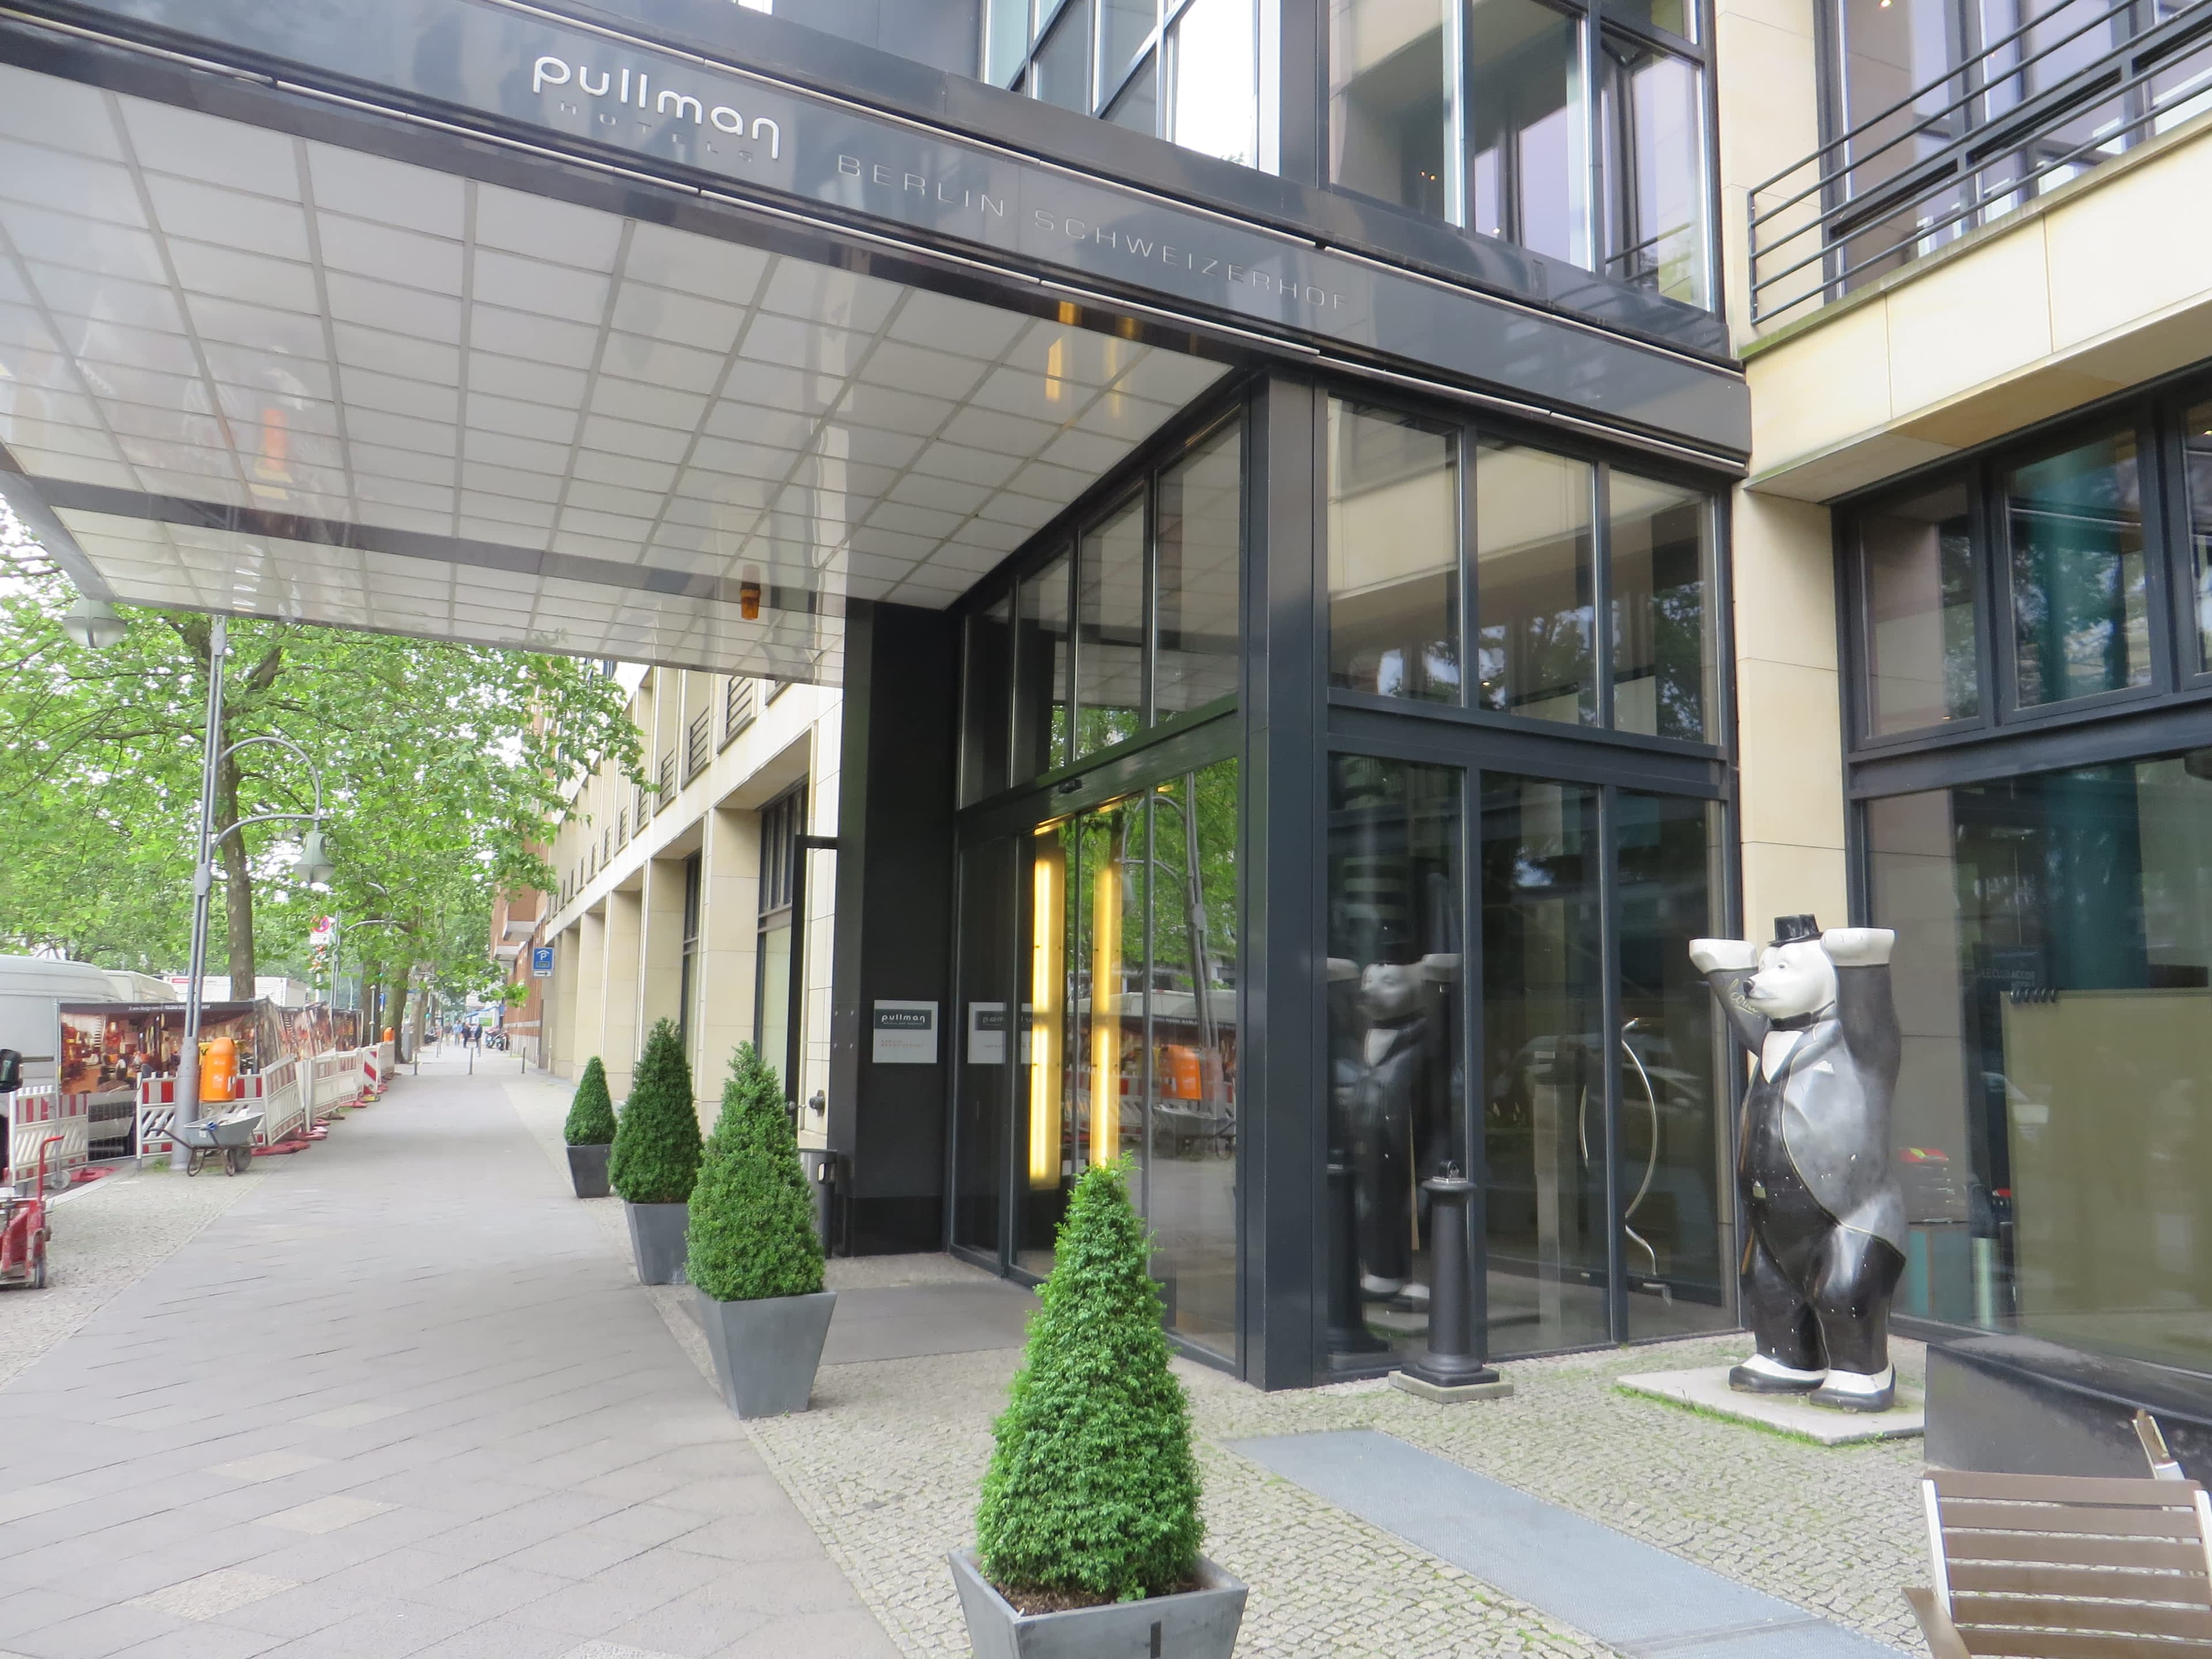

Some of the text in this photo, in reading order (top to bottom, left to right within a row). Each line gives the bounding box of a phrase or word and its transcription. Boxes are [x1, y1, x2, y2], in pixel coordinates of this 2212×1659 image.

[532, 56, 780, 160] pullman
[838, 154, 1349, 310] BERLIN SCHWEIZERHOF
[881, 1013, 925, 1024] pullman
